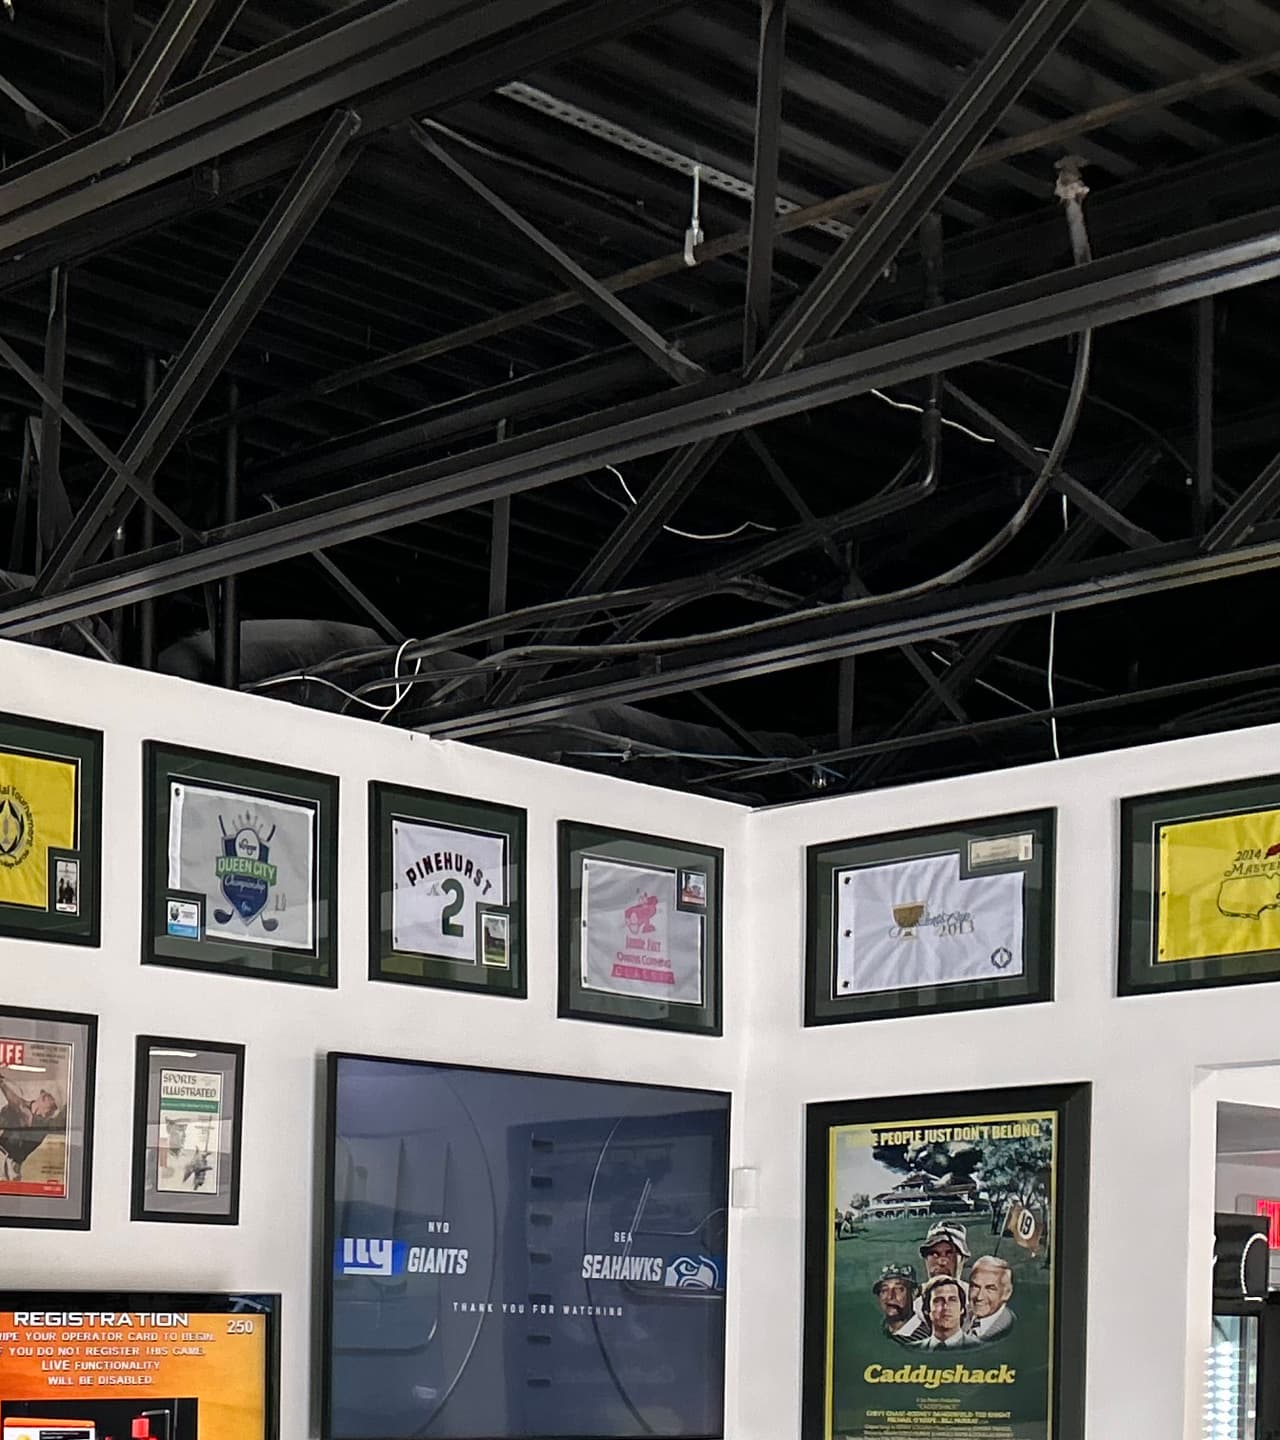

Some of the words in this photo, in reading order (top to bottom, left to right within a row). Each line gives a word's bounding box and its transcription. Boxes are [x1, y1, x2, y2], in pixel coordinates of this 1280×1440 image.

[218, 857, 252, 873] QUEEN
[253, 863, 276, 880] CITY
[405, 851, 492, 896] PINEHURST
[440, 878, 465, 938] 2
[163, 1072, 197, 1085] SPORTS
[162, 1085, 217, 1098] ILLUSTRATED
[880, 1129, 922, 1146] PEOPLE
[924, 1128, 953, 1144] JUST
[991, 1123, 1041, 1140] BELONG
[1020, 1213, 1032, 1236] 19
[613, 1231, 633, 1243] SEA
[407, 1247, 469, 1275] GIANTS
[581, 1255, 663, 1282] SEAHAWKS
[453, 1302, 494, 1313] THANK
[502, 1303, 525, 1314] YOU
[533, 1304, 555, 1315] FOR
[563, 1305, 624, 1317] WATCHING
[14, 1311, 189, 1327] REGISTRATION
[226, 1320, 255, 1335] 250
[25, 1331, 57, 1342] YOUR
[61, 1331, 123, 1342] OPERATOR
[127, 1331, 159, 1342] CARD
[163, 1332, 178, 1342] TO
[8, 1346, 33, 1357] YOU
[36, 1346, 53, 1357] DO
[57, 1346, 81, 1357] NOT
[85, 1346, 140, 1357] REGISTER
[144, 1346, 168, 1357] THIS
[41, 1360, 71, 1372] LIVE
[74, 1360, 160, 1371] FUNCTIONALITY
[47, 1375, 74, 1386] WILL
[79, 1375, 93, 1386] BE
[863, 1364, 1016, 1389] Caddyshack
